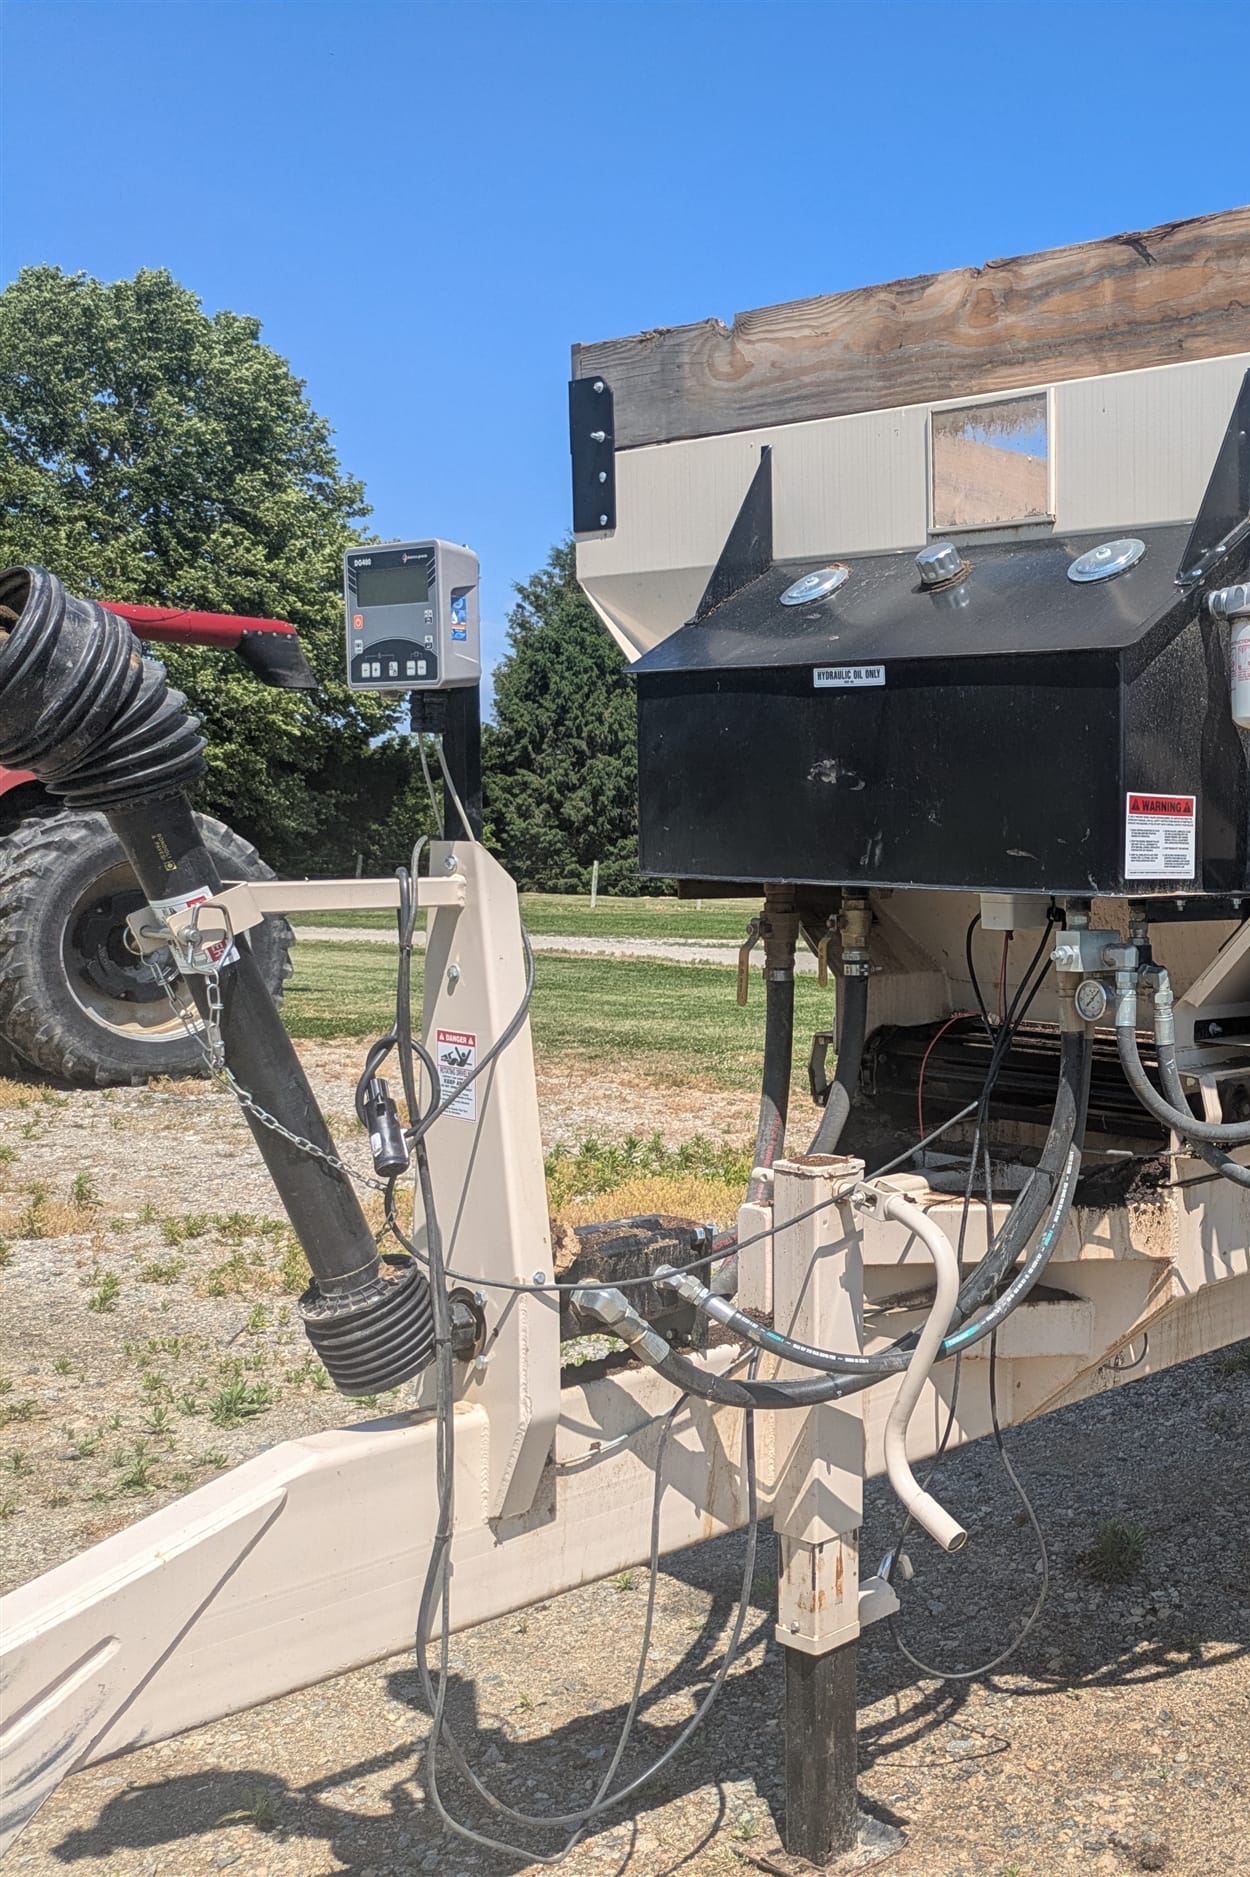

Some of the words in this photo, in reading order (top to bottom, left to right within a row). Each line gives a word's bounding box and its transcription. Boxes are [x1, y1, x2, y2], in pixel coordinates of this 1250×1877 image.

[817, 670, 851, 680] HYDRAULIC
[853, 670, 863, 679] OIL
[865, 669, 880, 679] ONLY
[1141, 800, 1182, 813] WARNING
[445, 1034, 468, 1043] DANGER
